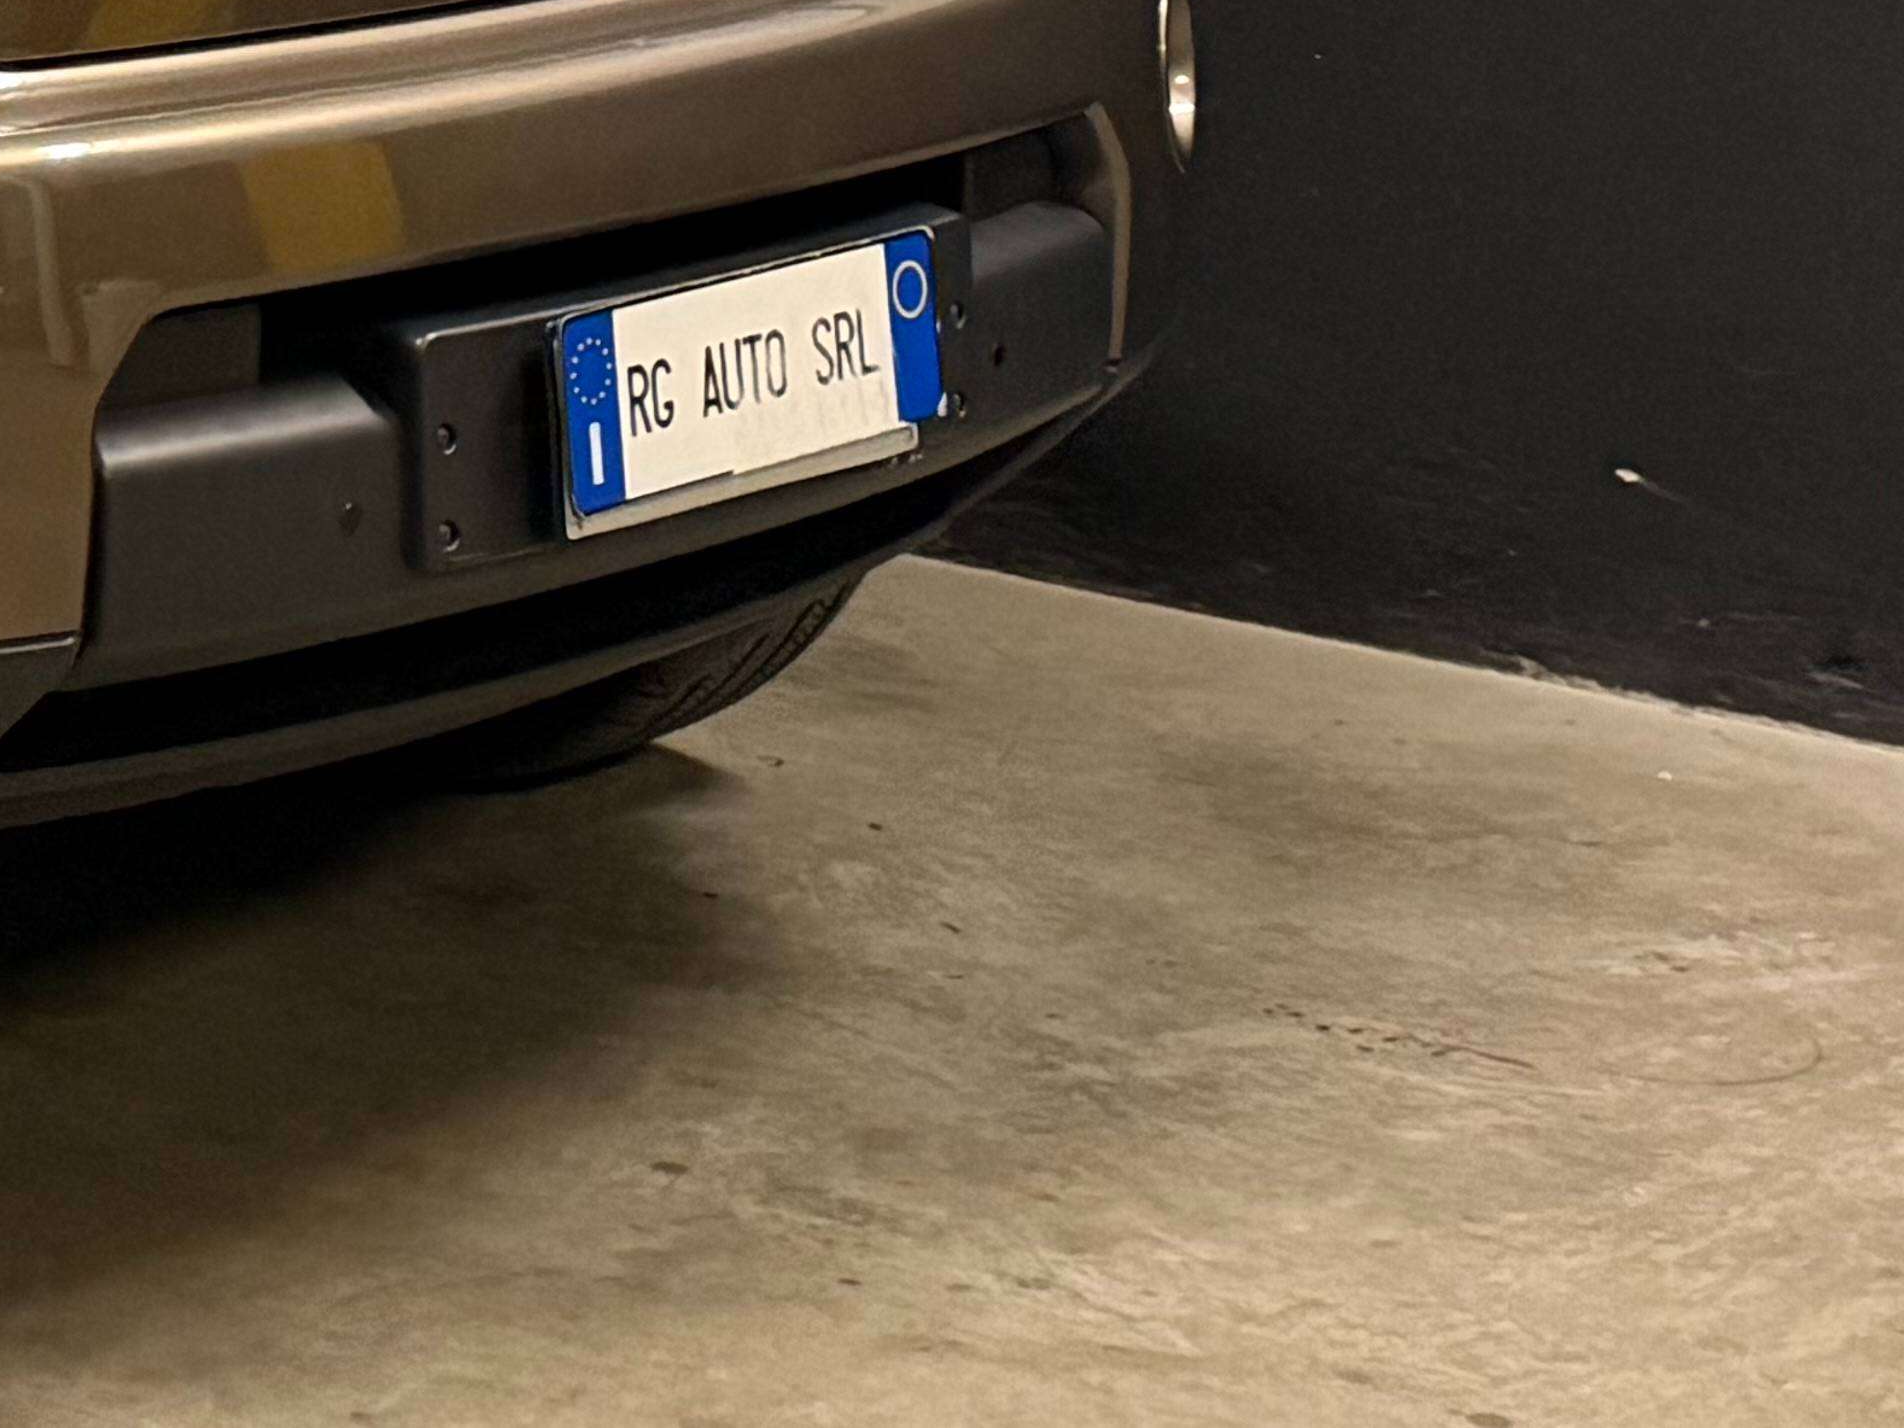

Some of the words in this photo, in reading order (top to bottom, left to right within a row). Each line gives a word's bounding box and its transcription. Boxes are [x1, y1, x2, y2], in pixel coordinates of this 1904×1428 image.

[626, 357, 675, 437] RG
[702, 328, 788, 419] AUTO
[810, 308, 882, 386] SRL
